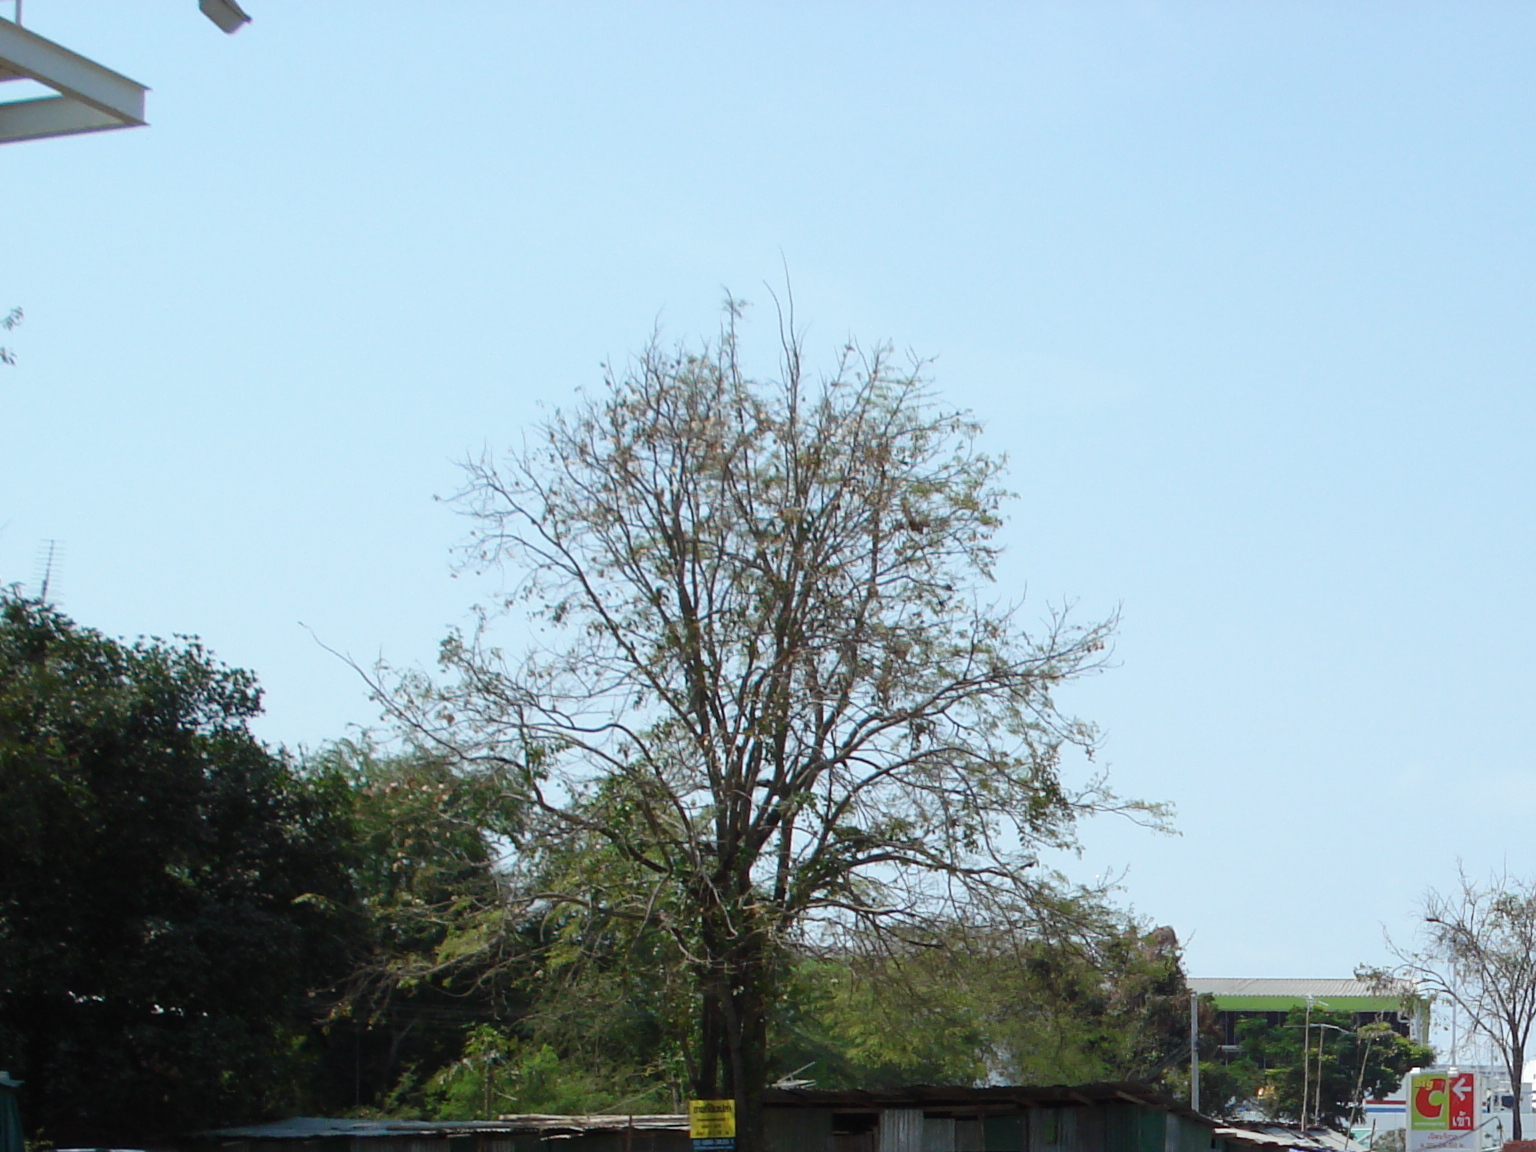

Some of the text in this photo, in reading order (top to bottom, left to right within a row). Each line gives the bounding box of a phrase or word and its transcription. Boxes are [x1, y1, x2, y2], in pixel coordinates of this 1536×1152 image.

[1415, 1079, 1434, 1091] Big
[1415, 1078, 1446, 1118] C
[1452, 1111, 1471, 1127] เข้า
